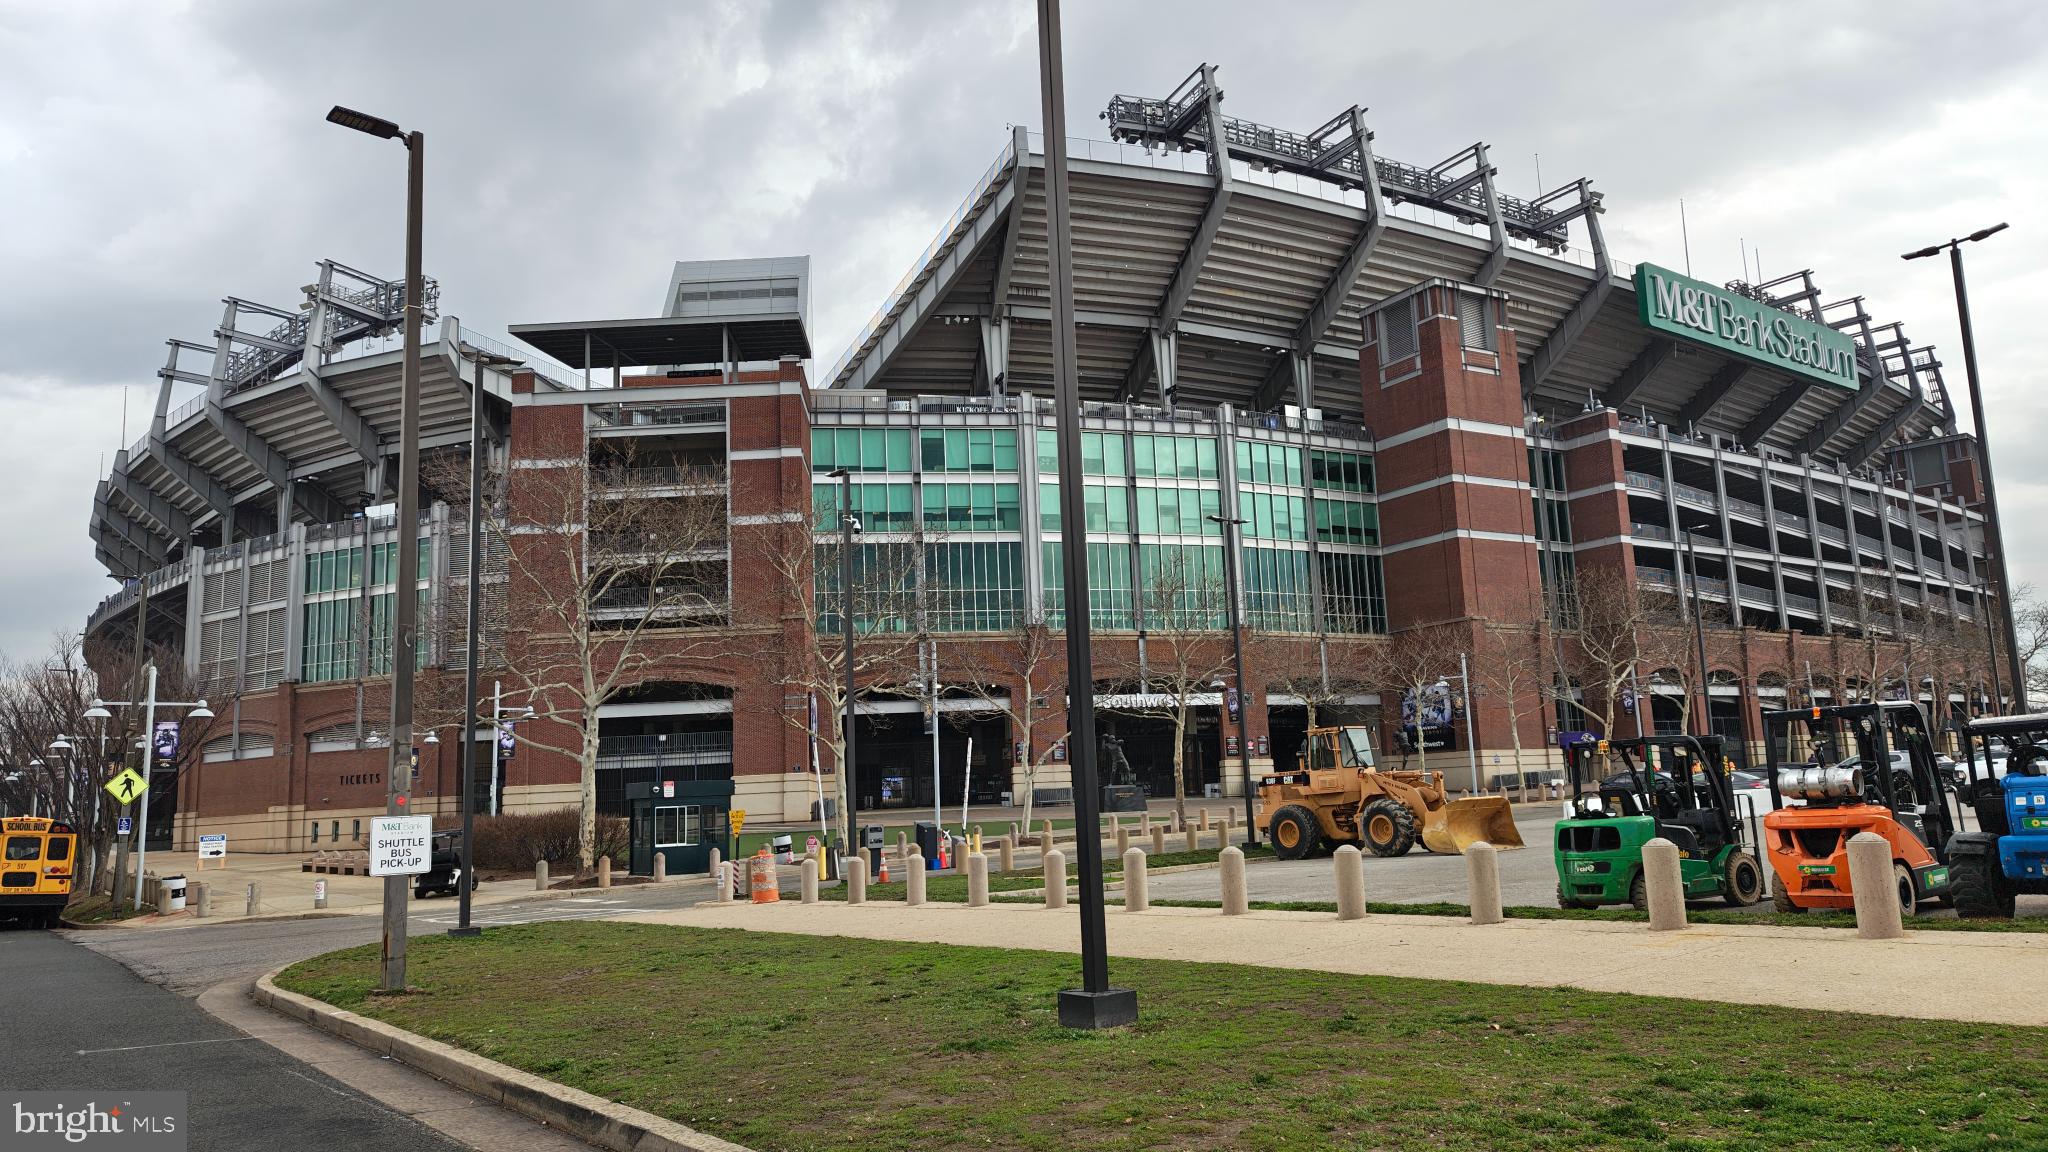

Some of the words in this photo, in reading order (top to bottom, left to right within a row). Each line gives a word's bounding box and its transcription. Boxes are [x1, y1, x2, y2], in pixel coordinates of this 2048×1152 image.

[1651, 274, 1717, 333] M&T
[1717, 297, 1776, 354] Bank
[1773, 317, 1856, 380] Stadium
[339, 773, 380, 785] TICKETS
[7, 822, 31, 831] SCHOOL
[33, 822, 47, 831] BUS
[382, 822, 401, 831] M&T
[403, 822, 423, 830] Bank
[378, 837, 425, 849] SHUTTLE
[390, 848, 412, 858] BUS
[380, 857, 422, 869] PICK-UP
